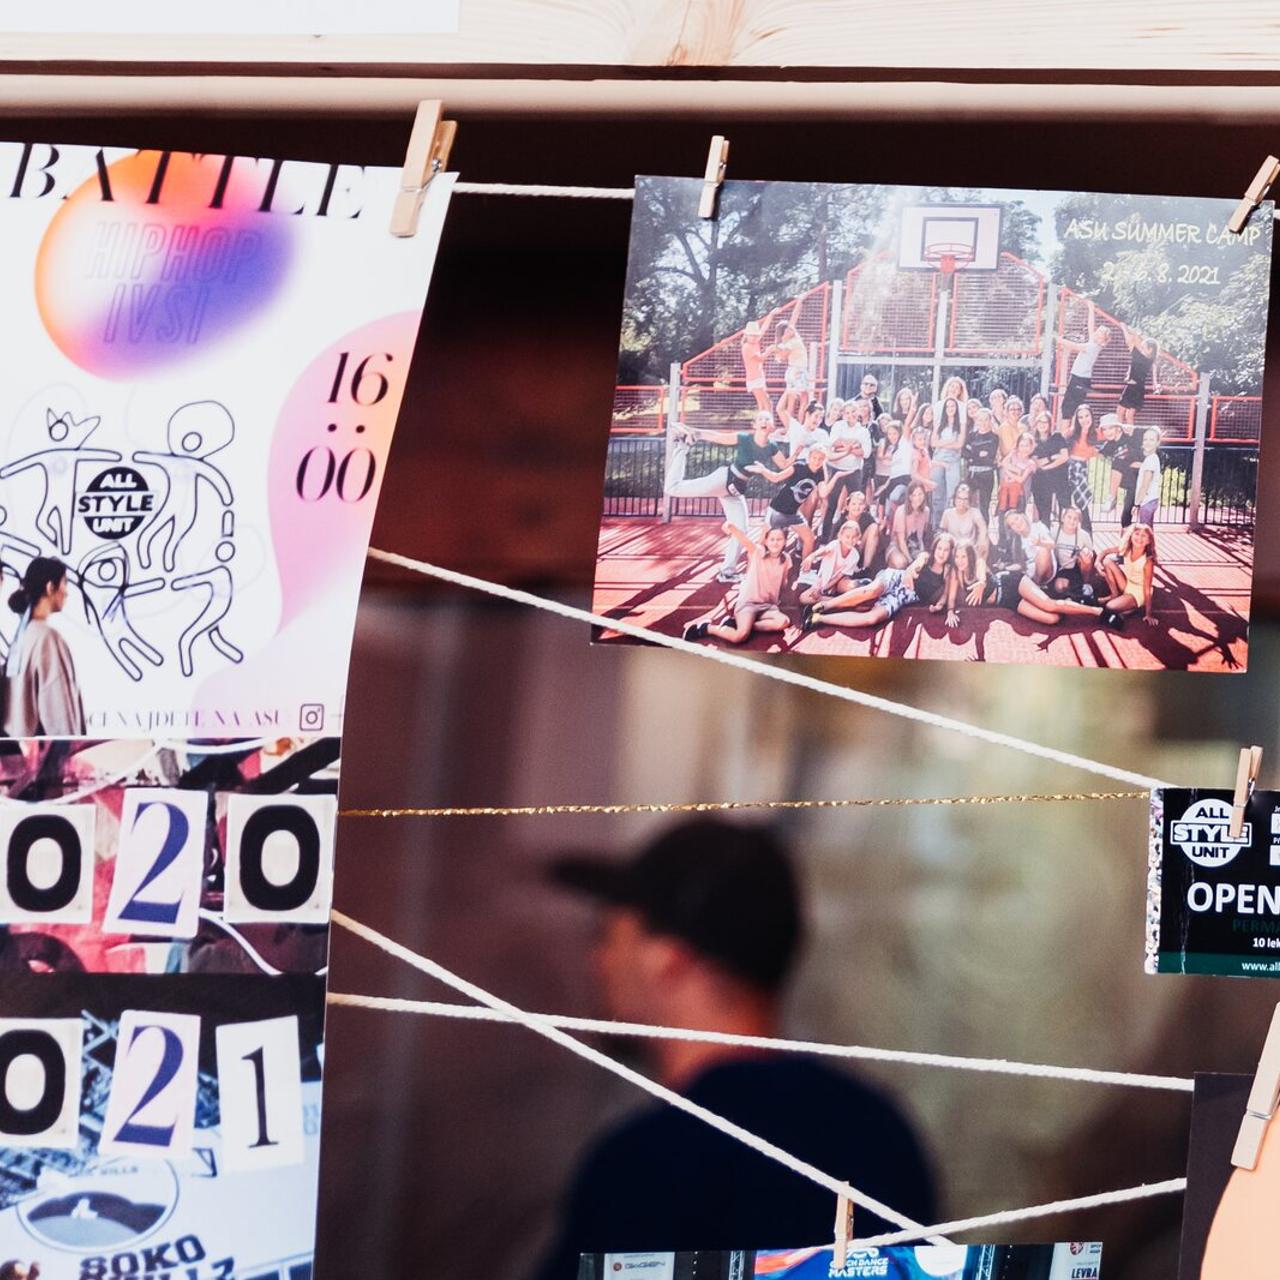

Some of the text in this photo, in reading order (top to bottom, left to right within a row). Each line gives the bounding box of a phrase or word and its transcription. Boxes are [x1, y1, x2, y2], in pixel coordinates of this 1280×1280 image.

[9, 143, 366, 219] BATTLE
[1112, 220, 1201, 244] SUMMER
[1206, 222, 1261, 247] CAMP
[85, 221, 262, 284] HIPHOP
[1177, 264, 1221, 285] 2021
[328, 351, 394, 407] 16
[99, 473, 138, 489] ALL
[296, 446, 377, 503] 00
[78, 494, 154, 513] STYLE
[92, 517, 135, 534] UNIT
[1195, 806, 1230, 819] ALL
[1191, 845, 1230, 859] UNIT
[1253, 937, 1265, 948] 10
